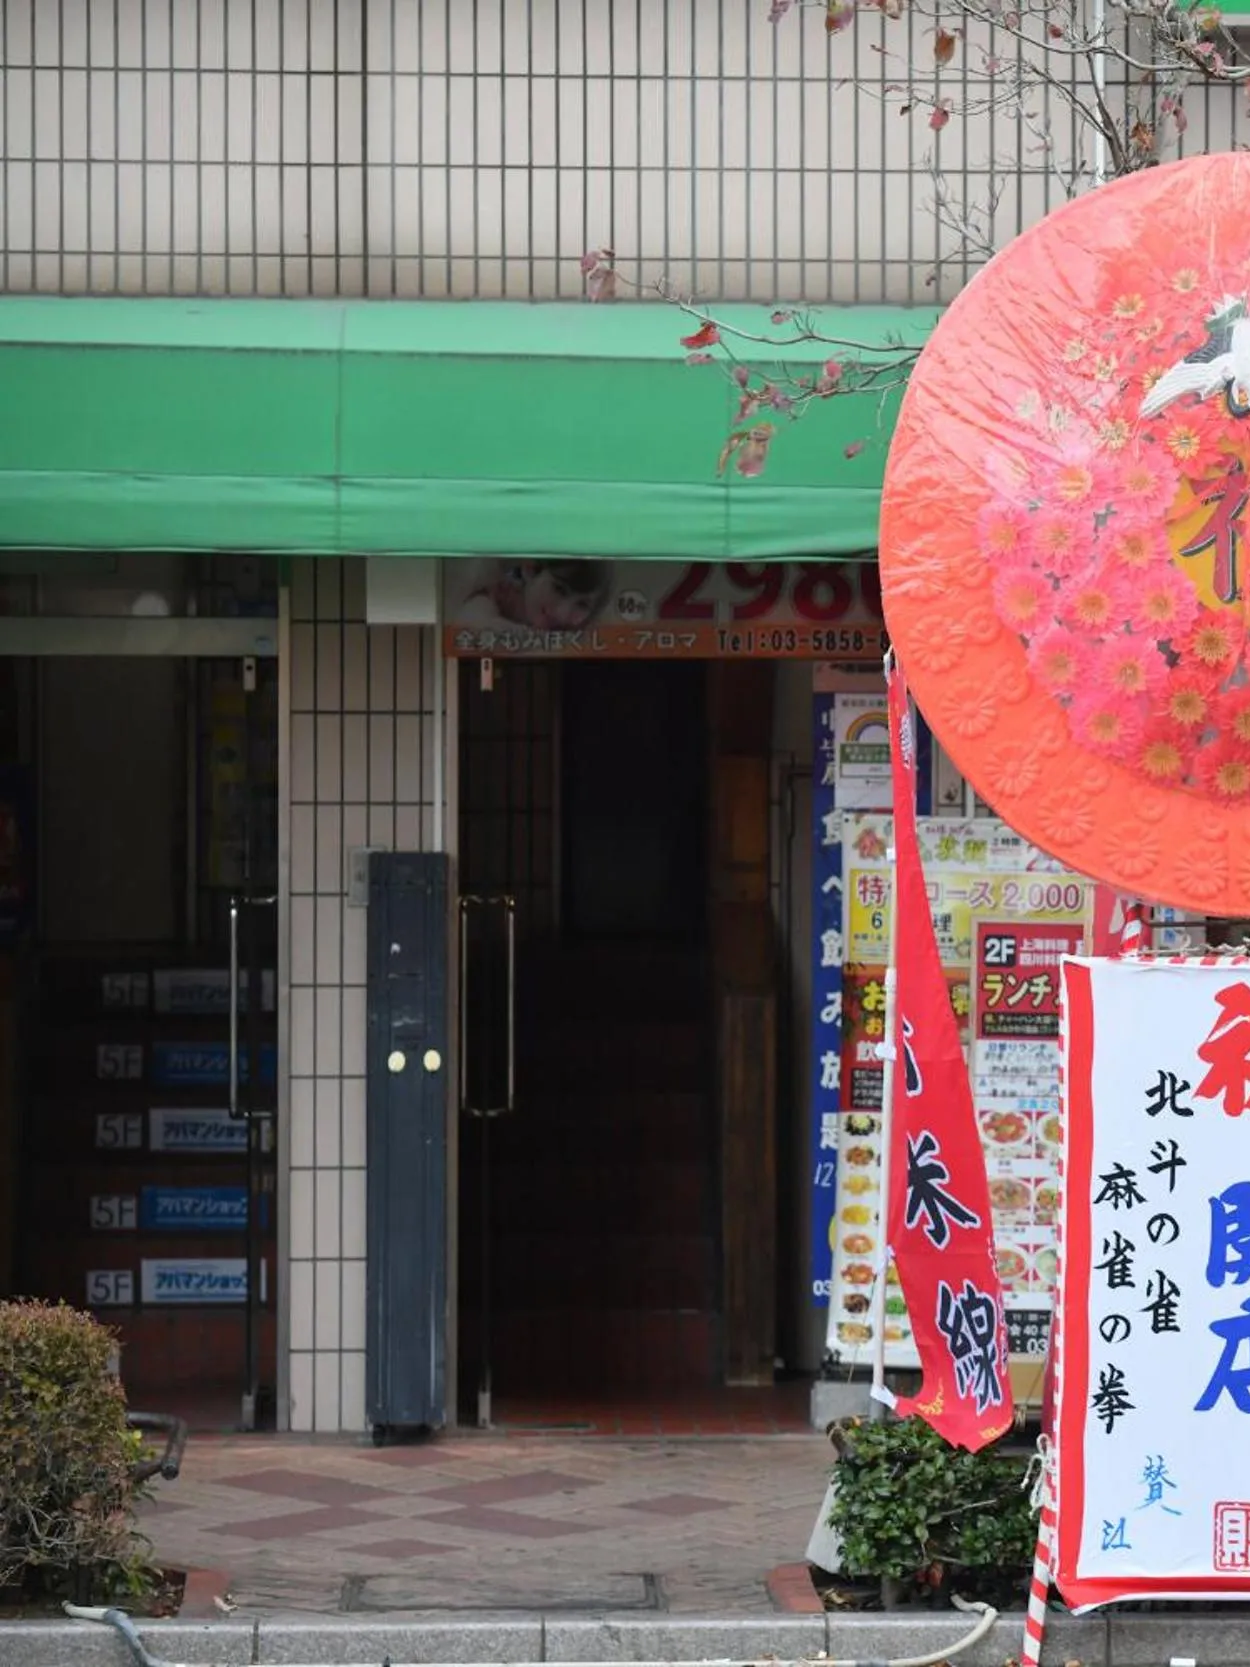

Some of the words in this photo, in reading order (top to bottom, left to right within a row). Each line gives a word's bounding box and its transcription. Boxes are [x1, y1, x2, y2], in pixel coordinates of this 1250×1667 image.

[985, 937, 1016, 964] 2F
[983, 973, 1059, 1006] ランチ
[101, 1048, 142, 1078] 5F
[101, 1117, 142, 1146] 5F
[95, 1199, 135, 1227] 5F
[1140, 1069, 1194, 1336] 北斗の雀
[91, 1274, 132, 1302] 5F
[1088, 1162, 1148, 1436] 麻雀の拳
